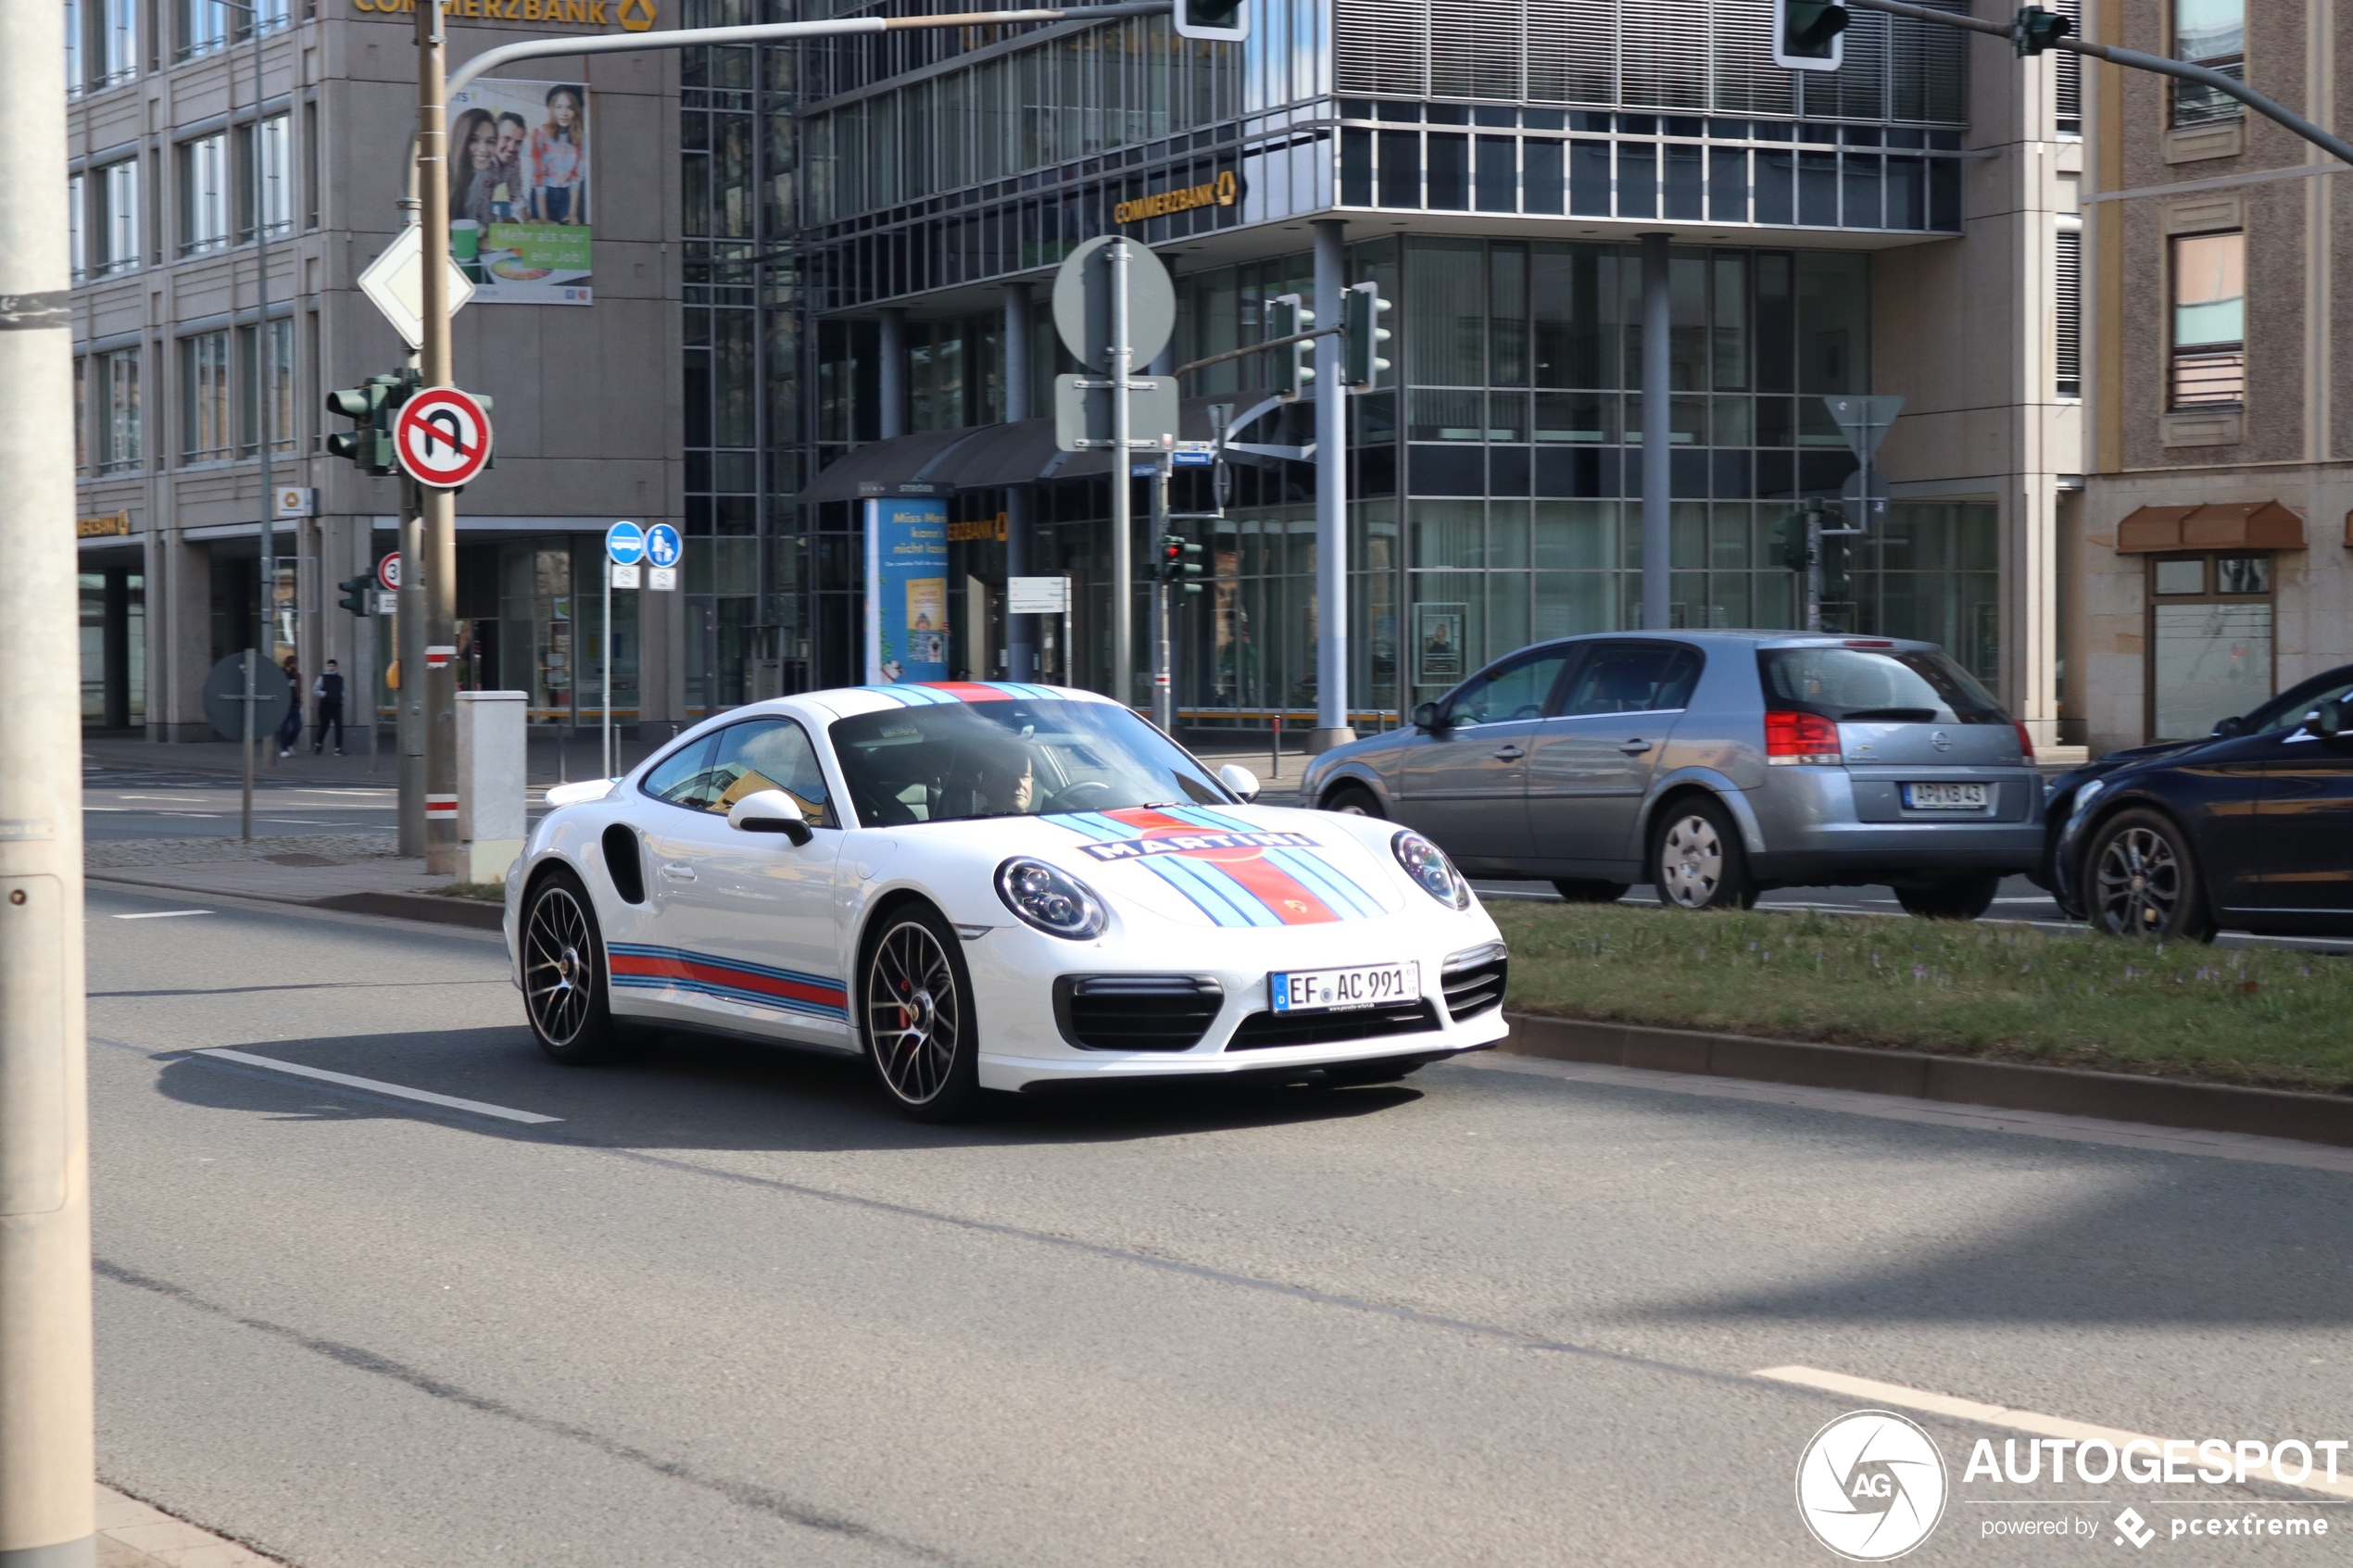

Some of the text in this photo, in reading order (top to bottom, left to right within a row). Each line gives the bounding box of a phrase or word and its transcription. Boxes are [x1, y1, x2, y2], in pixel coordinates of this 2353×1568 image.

[354, 0, 608, 24] OMERZBANK
[1114, 182, 1214, 223] COMMERZBANK
[893, 512, 922, 523] Miss
[389, 564, 399, 580] 3
[1965, 785, 1981, 802] 43
[1090, 833, 1311, 859] MARTINI
[1290, 970, 1404, 1004] EF AC 991
[1278, 996, 1285, 1004] D
